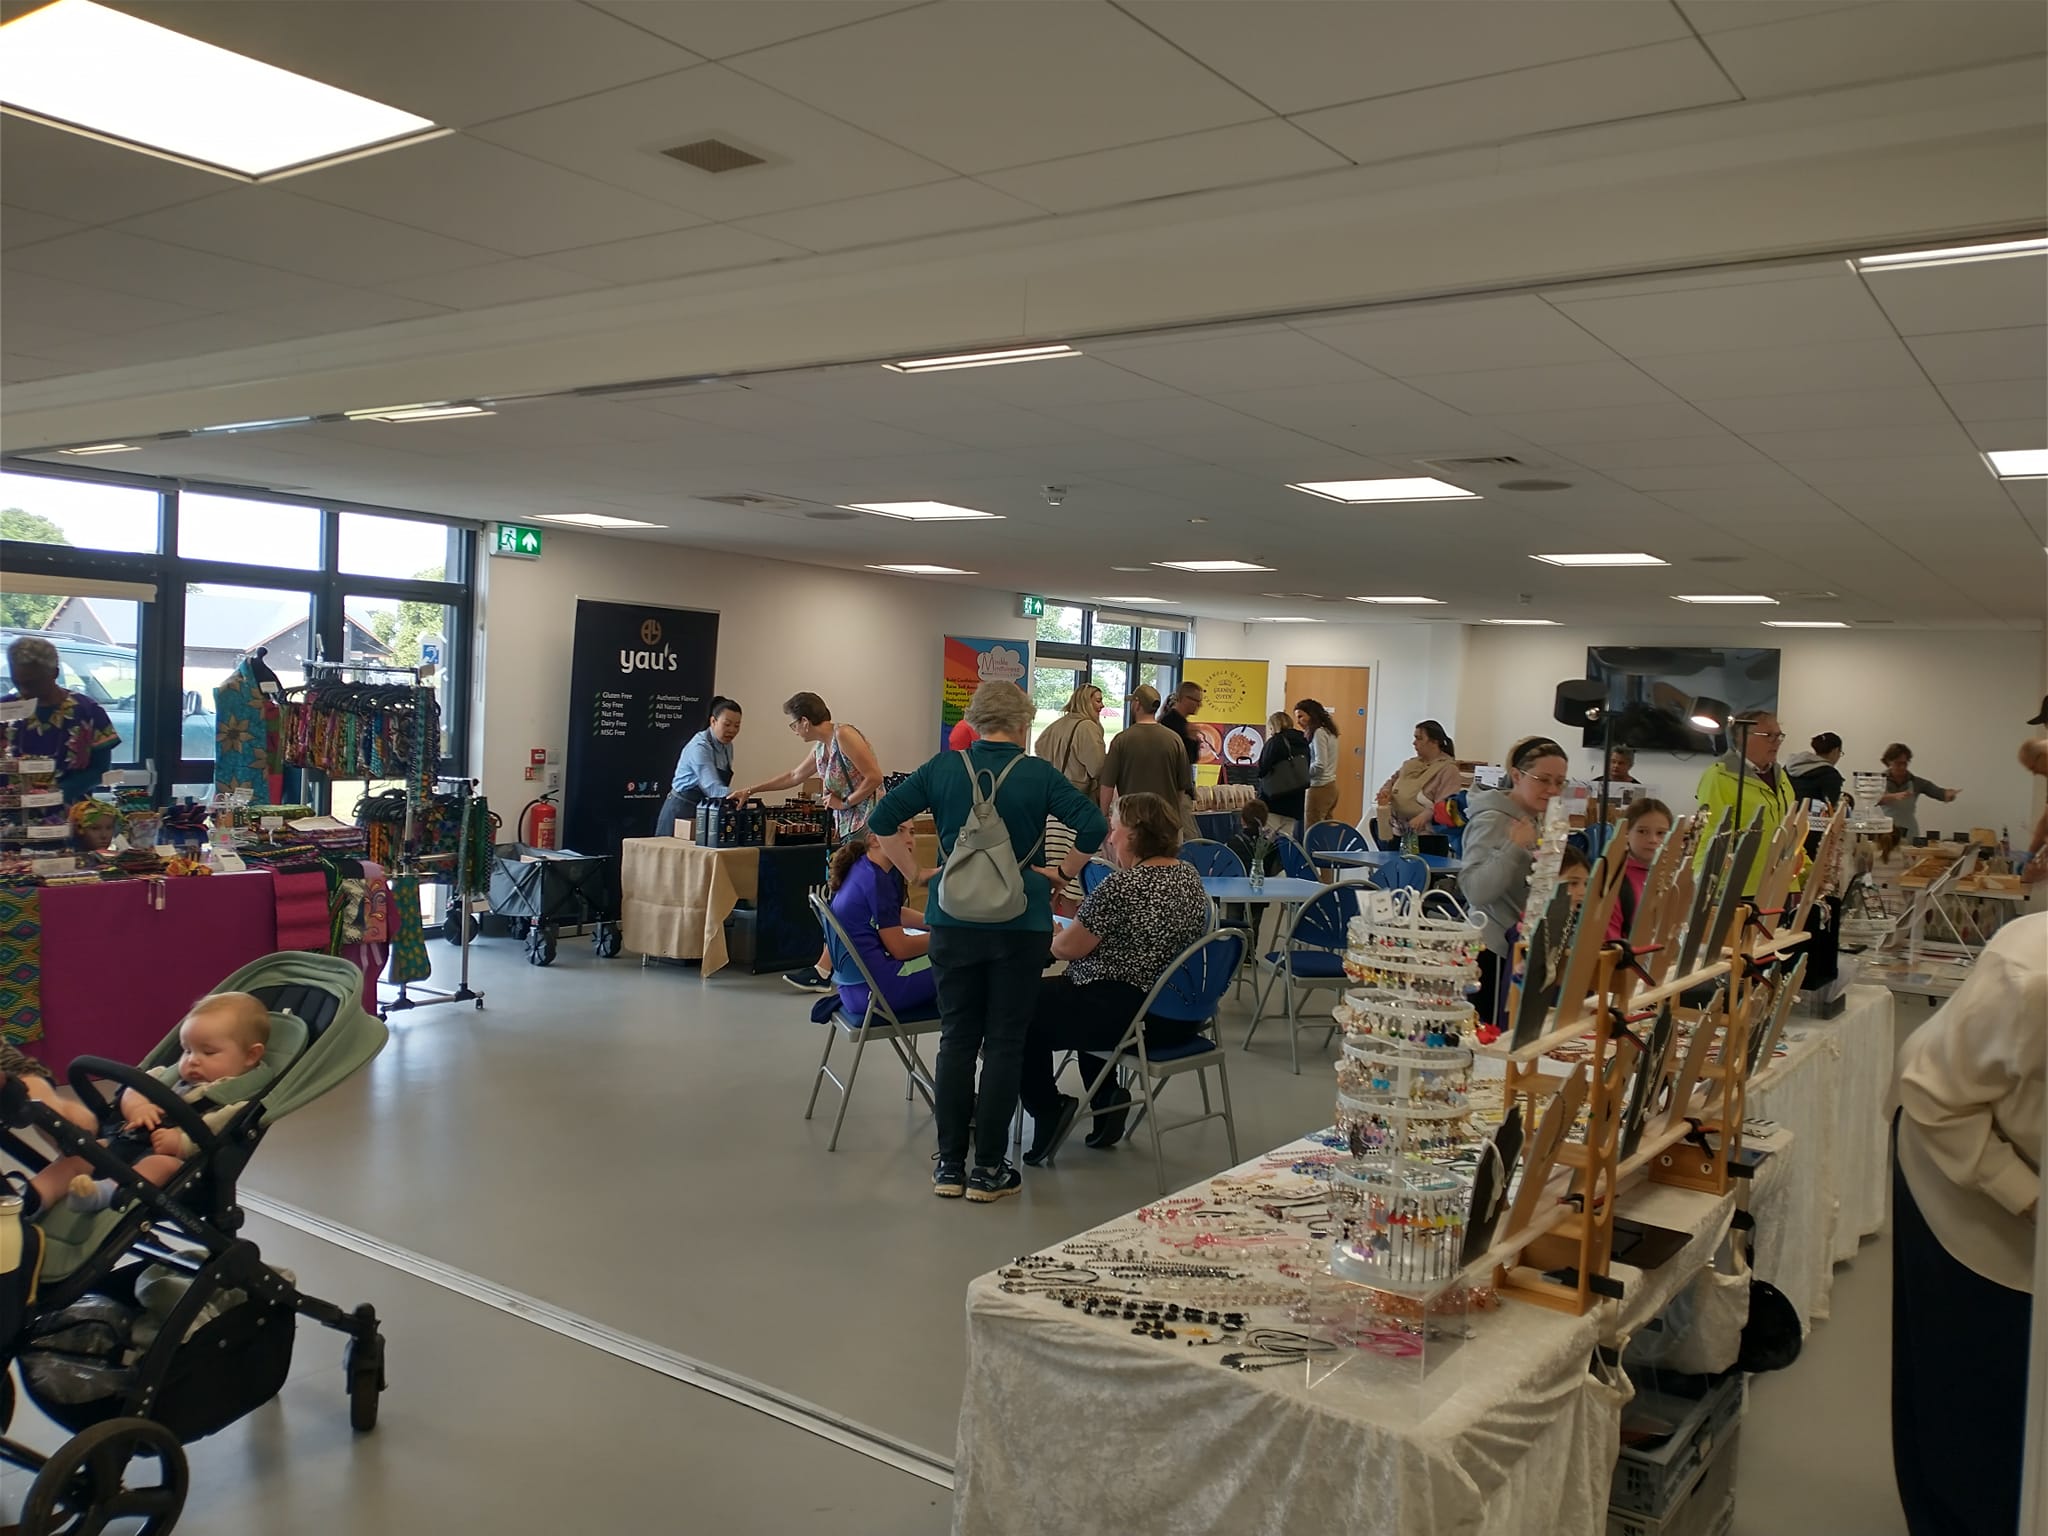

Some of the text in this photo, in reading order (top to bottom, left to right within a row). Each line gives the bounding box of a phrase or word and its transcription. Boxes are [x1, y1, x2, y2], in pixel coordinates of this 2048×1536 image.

[620, 642, 677, 674] yau's
[601, 701, 612, 709] Soy
[600, 720, 615, 728] Dairy
